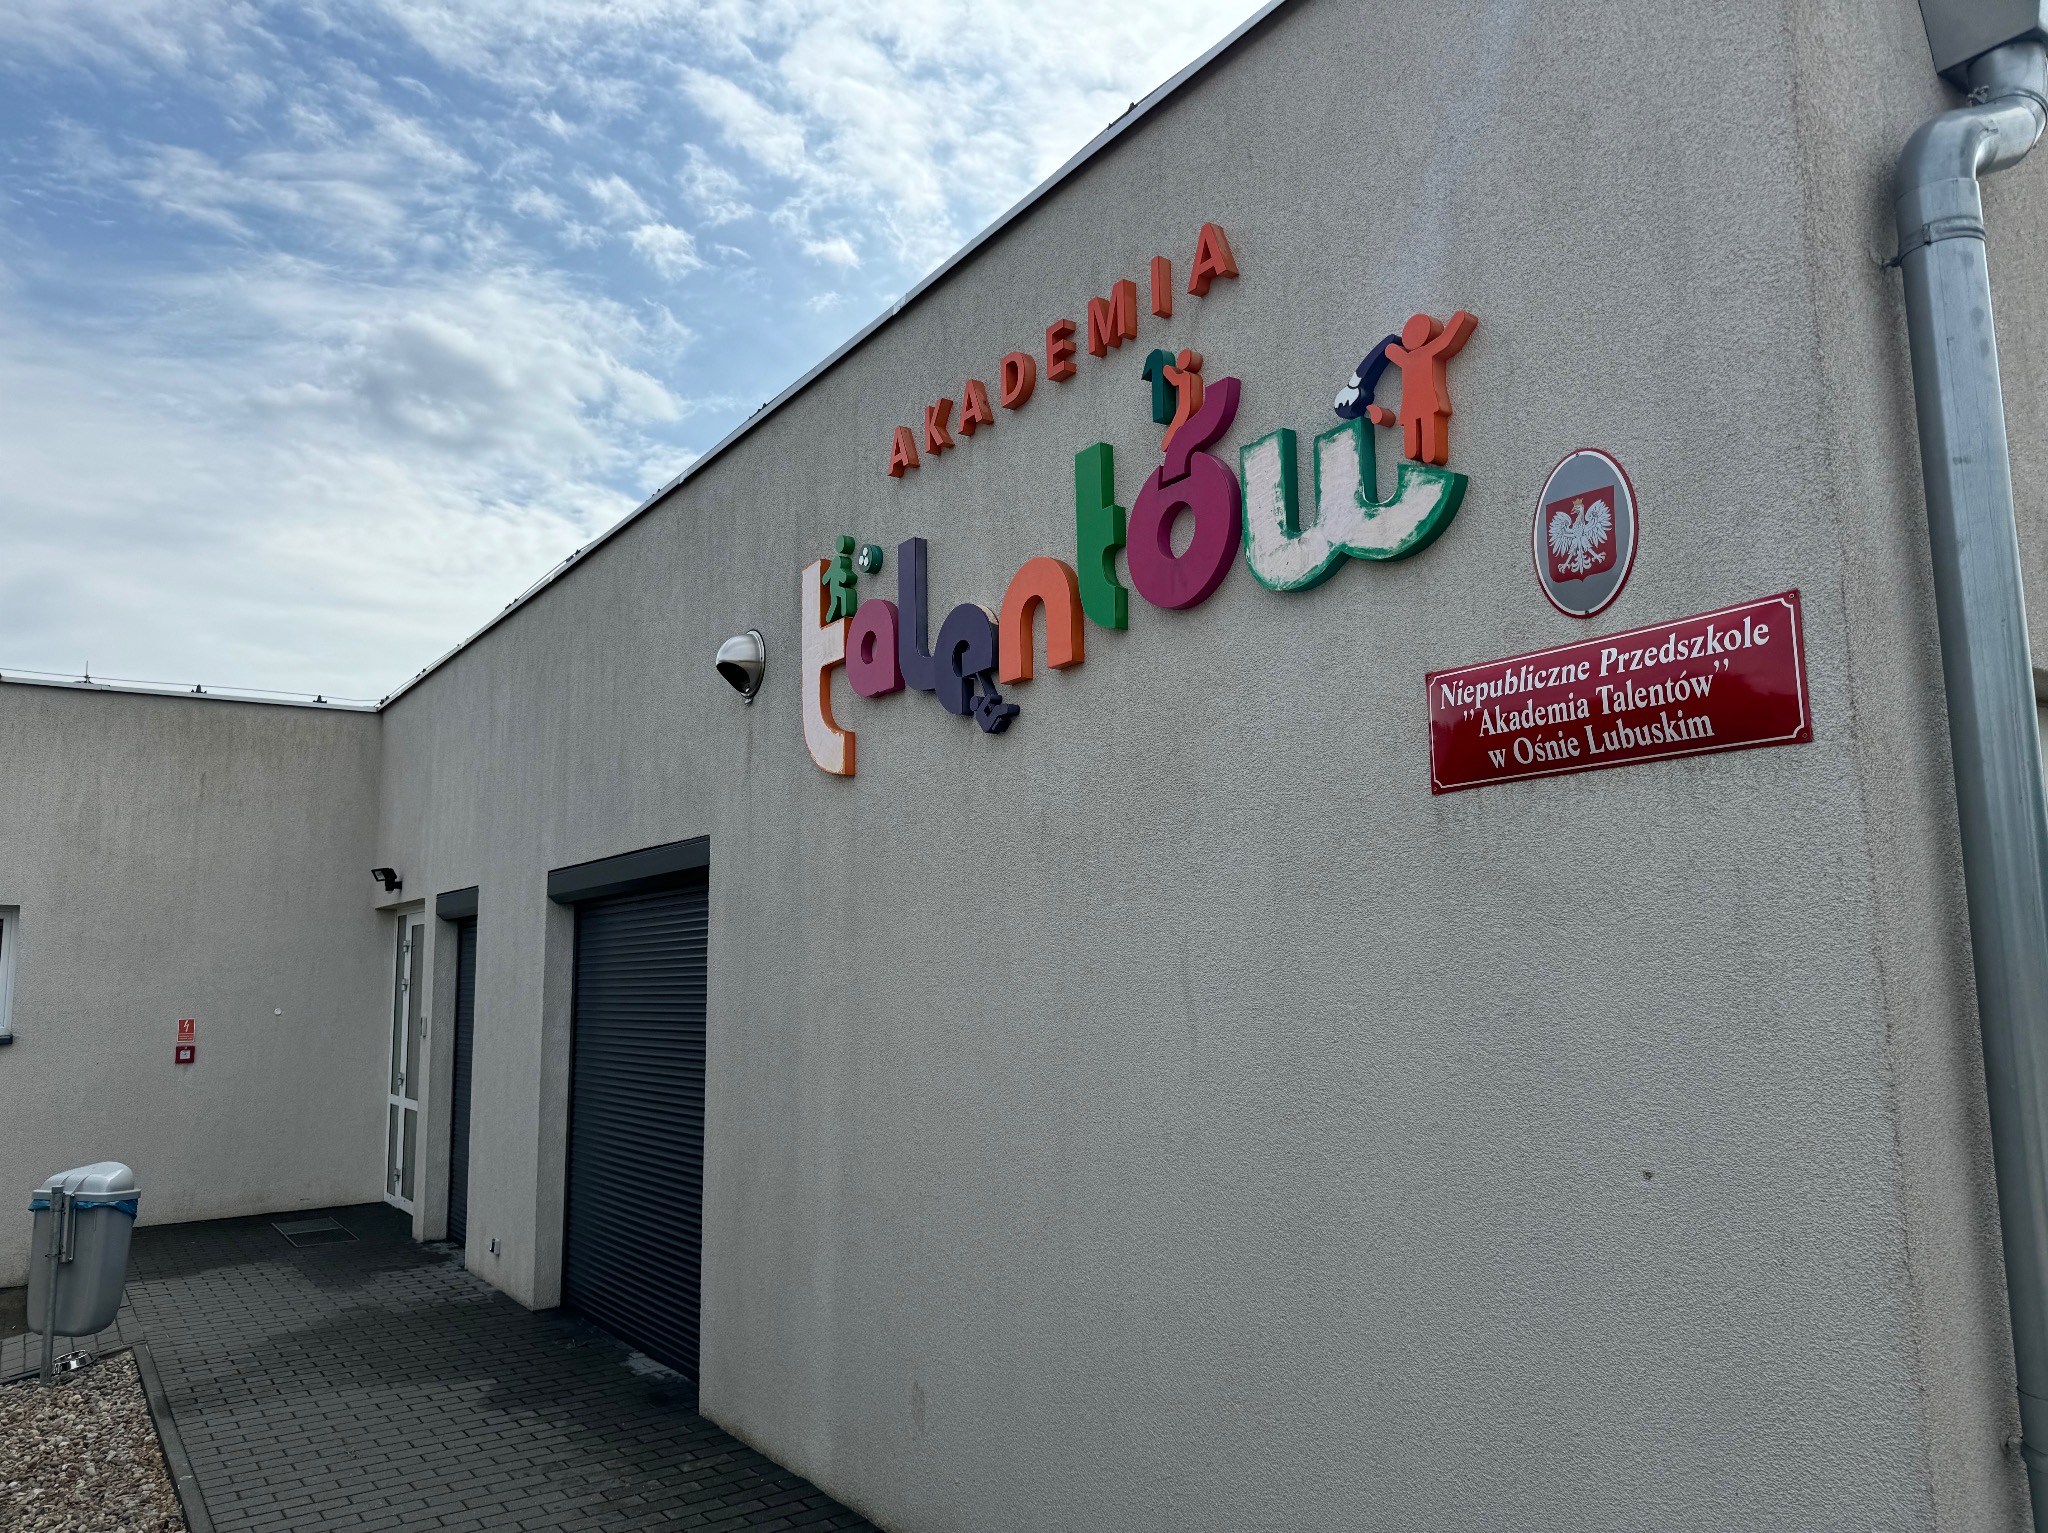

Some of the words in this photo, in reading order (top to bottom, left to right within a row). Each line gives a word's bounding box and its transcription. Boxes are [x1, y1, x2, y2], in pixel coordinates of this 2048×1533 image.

[888, 222, 1240, 478] AKADEMIA
[1440, 660, 1590, 710] Niepubliczne
[1599, 616, 1770, 678] Przedszkole
[1488, 748, 1506, 769] w
[1513, 731, 1581, 765] Ośnie
[1585, 710, 1715, 754] Lubuskim
